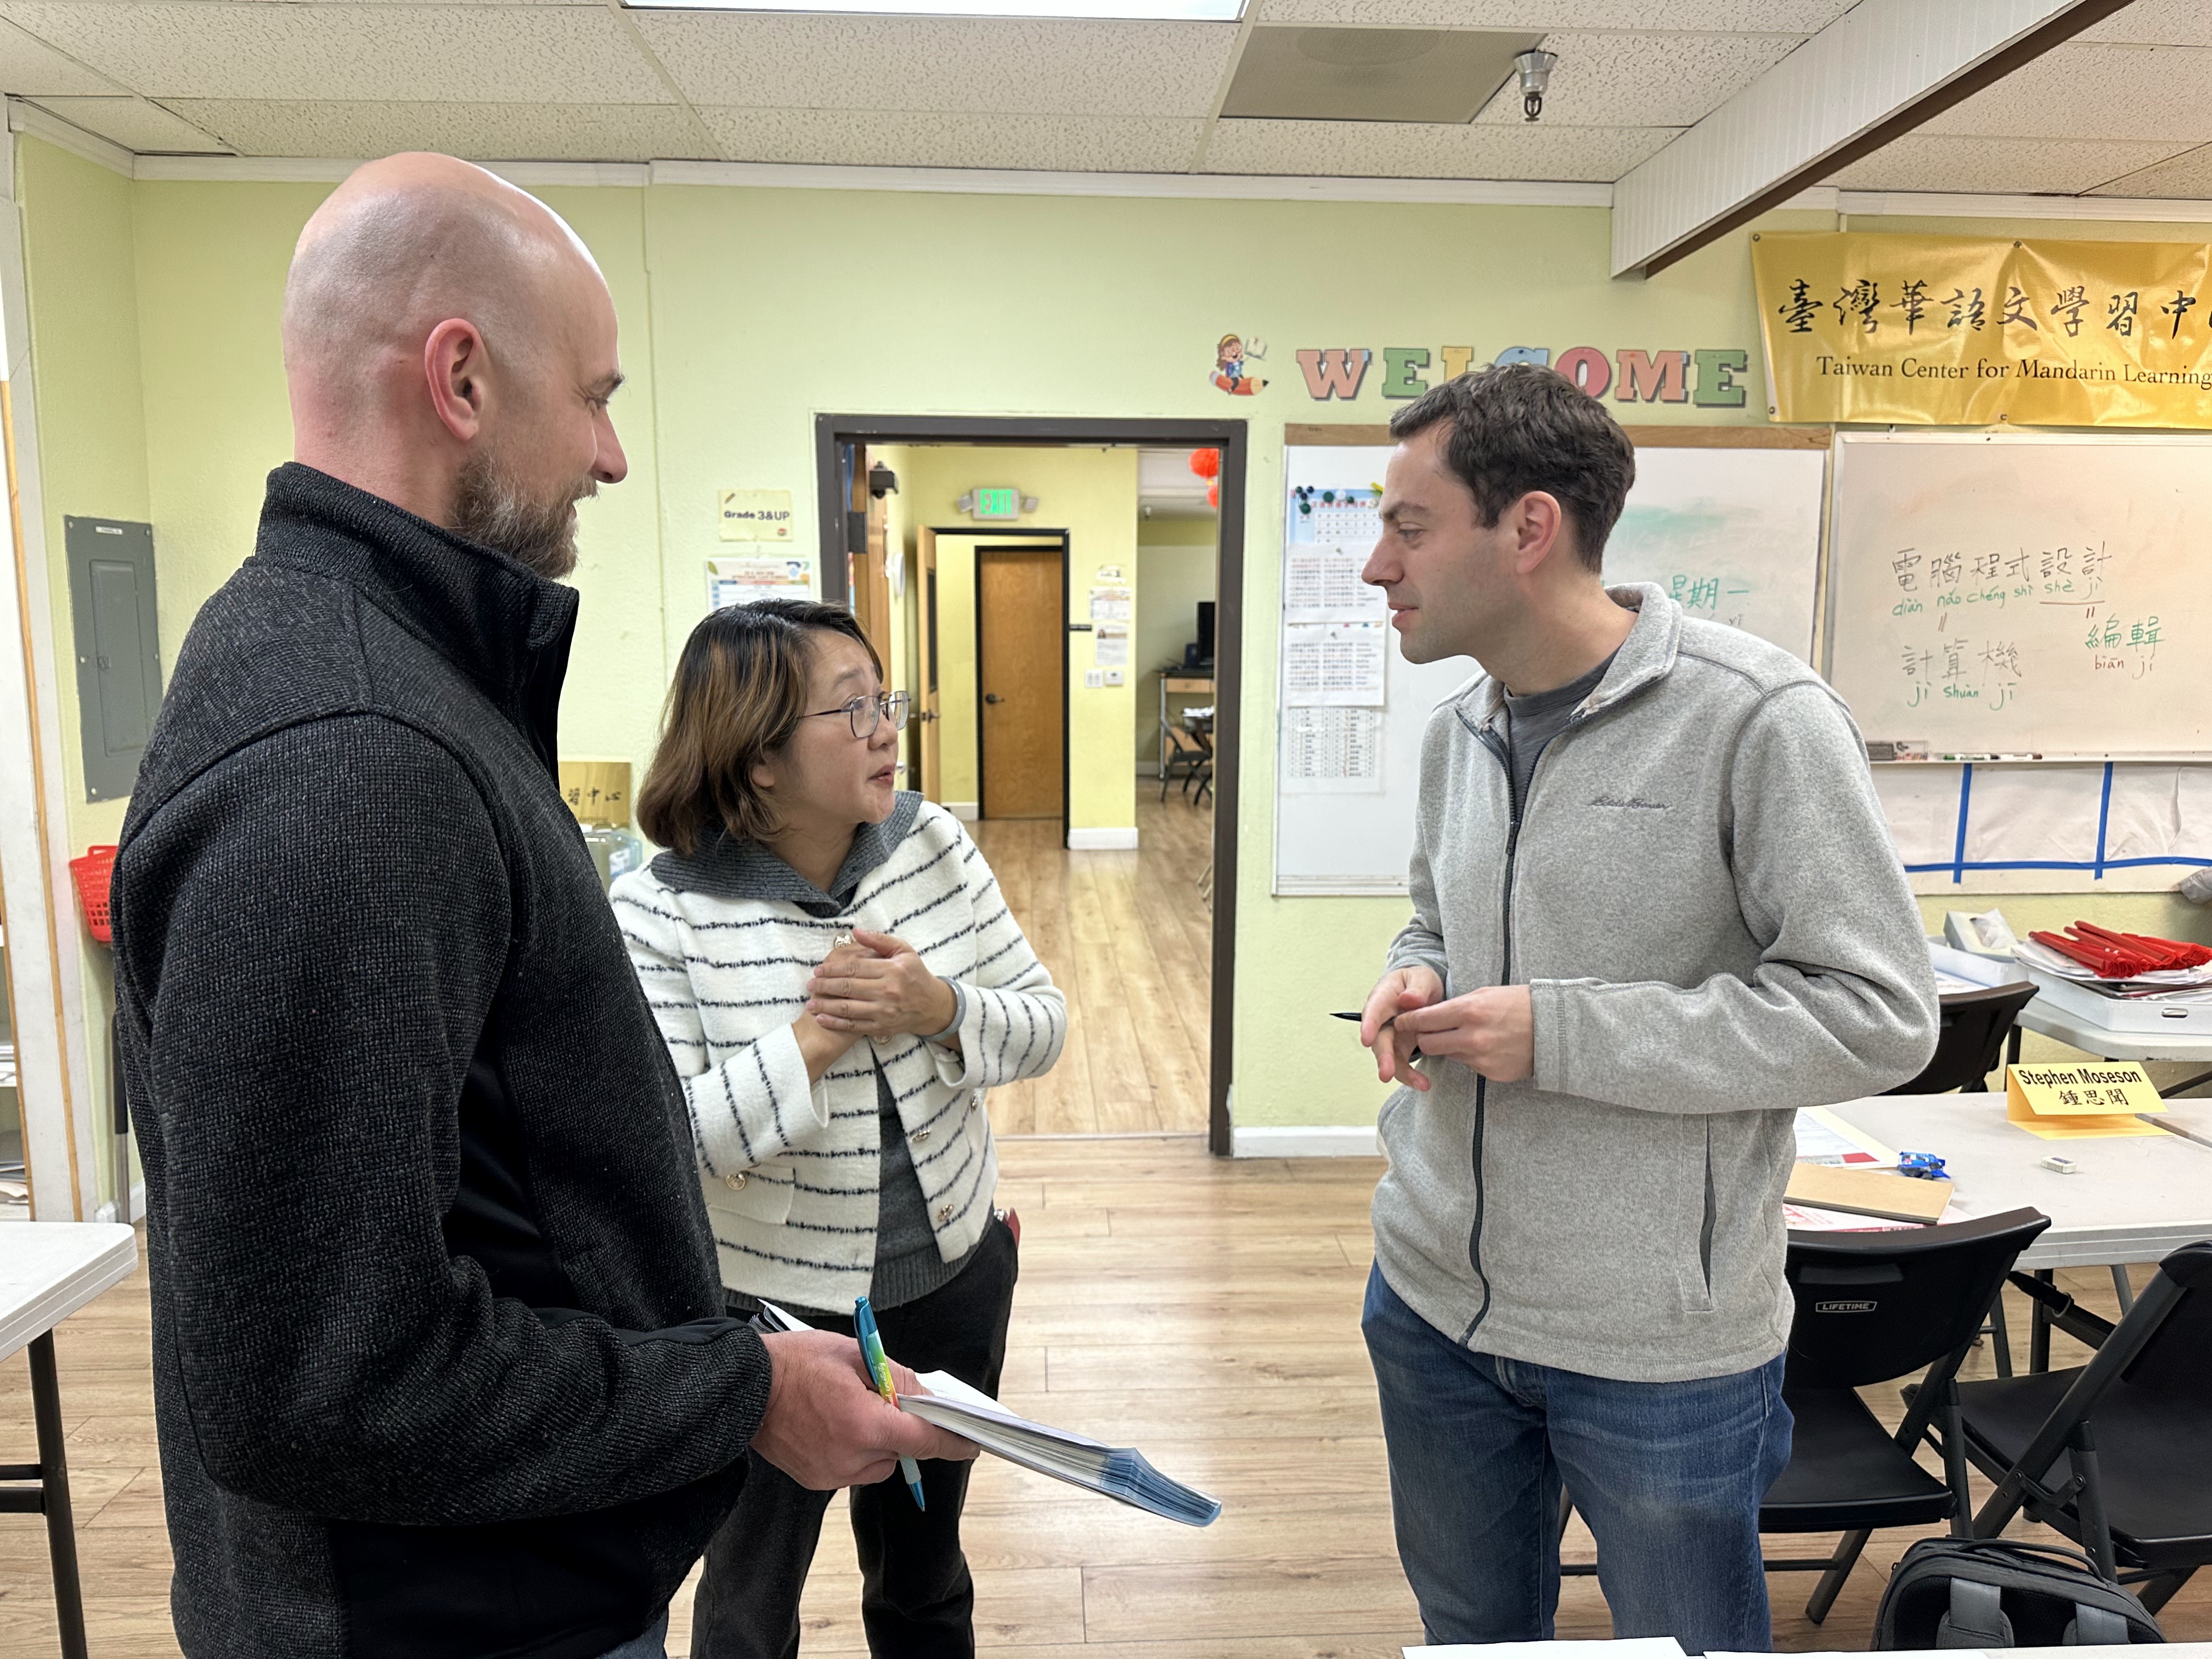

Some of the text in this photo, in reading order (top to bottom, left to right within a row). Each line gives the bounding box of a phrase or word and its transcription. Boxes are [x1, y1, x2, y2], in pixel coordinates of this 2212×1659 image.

[1778, 279, 2212, 339] 臺灣華語文學習中
[1816, 356, 2212, 391] Taiwan Center for Mandarin Learning
[724, 510, 791, 521] Grade 3&UP
[980, 488, 1012, 515] EXIT
[1892, 540, 2112, 592] 電腦程式設計
[1669, 574, 1749, 610] 星期一
[2084, 613, 2165, 655] 編輯
[1901, 637, 2022, 682] 計算機
[2018, 1069, 2142, 1088] Stephen Moseson
